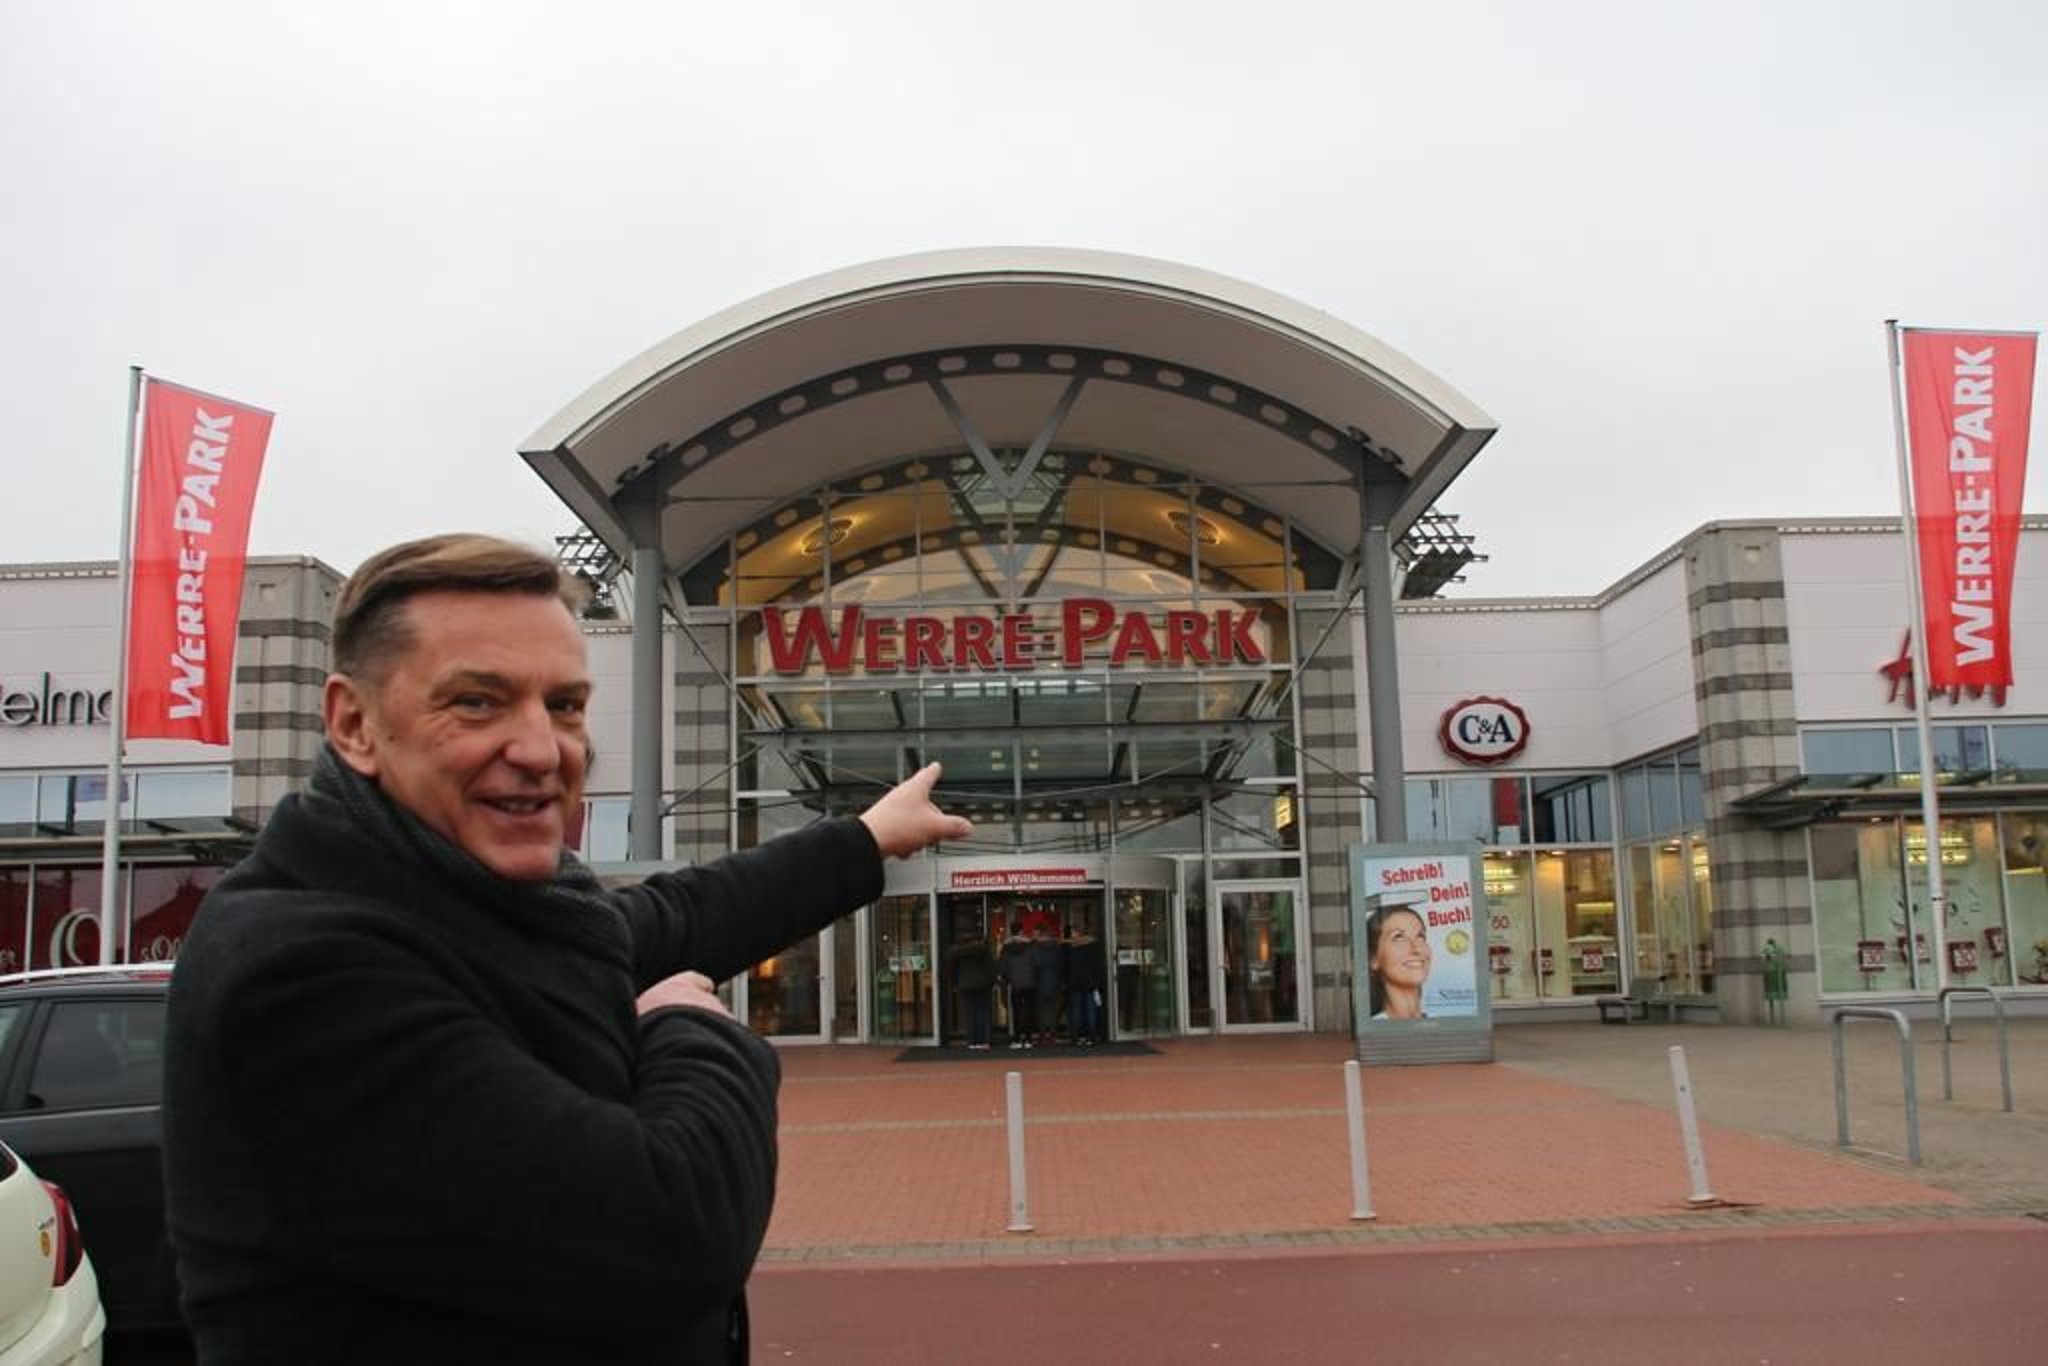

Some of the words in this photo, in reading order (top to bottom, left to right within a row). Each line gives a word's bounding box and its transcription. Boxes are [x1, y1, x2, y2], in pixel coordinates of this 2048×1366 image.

[1951, 346, 1994, 667] WERRE-PARK
[169, 407, 234, 719] WERRE-PARK
[0, 672, 112, 726] elm
[1458, 713, 1515, 744] C&A
[953, 875, 1005, 886] Herzlich
[1008, 873, 1087, 885] Willkommen
[1381, 863, 1444, 885] Schreib!
[1431, 882, 1470, 902] Dein!
[1428, 906, 1472, 927] Buch!
